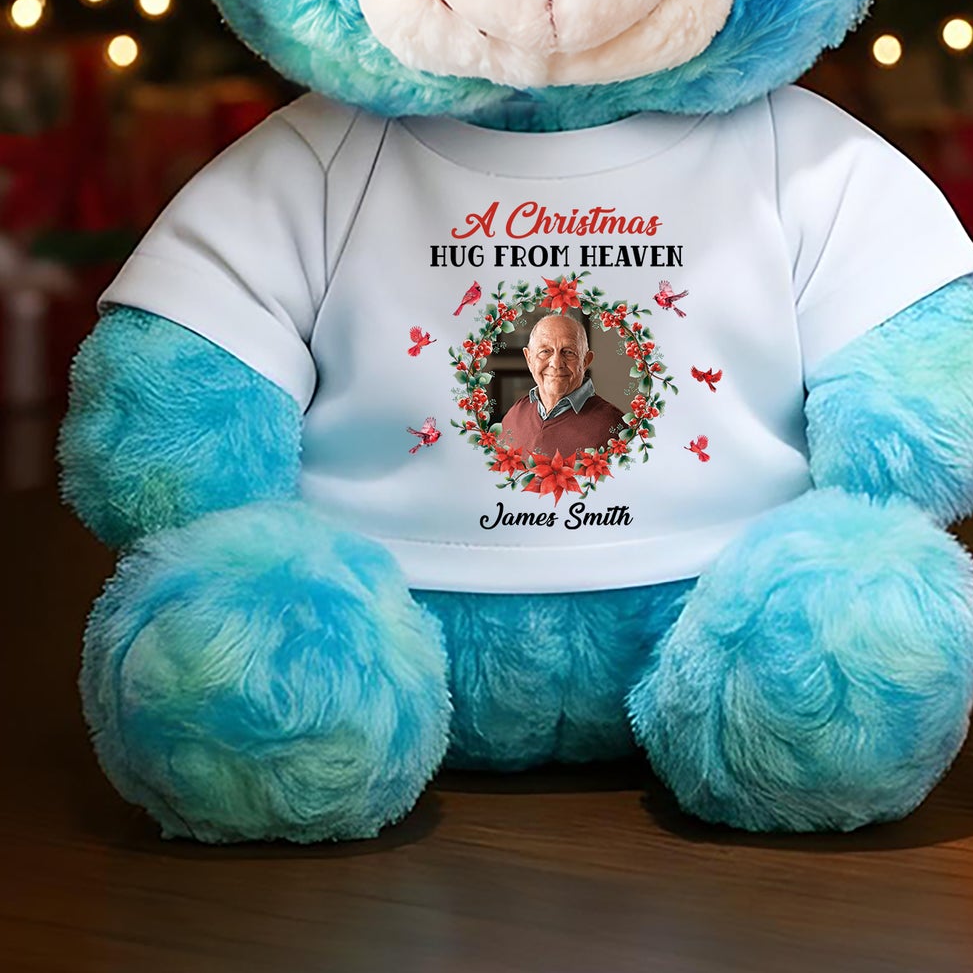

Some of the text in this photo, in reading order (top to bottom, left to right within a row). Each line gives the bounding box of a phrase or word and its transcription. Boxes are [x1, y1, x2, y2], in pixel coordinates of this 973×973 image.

[450, 201, 663, 240] A Christmas
[429, 244, 684, 268] HUG FROM HEAVEN
[479, 501, 634, 531] James Smith
